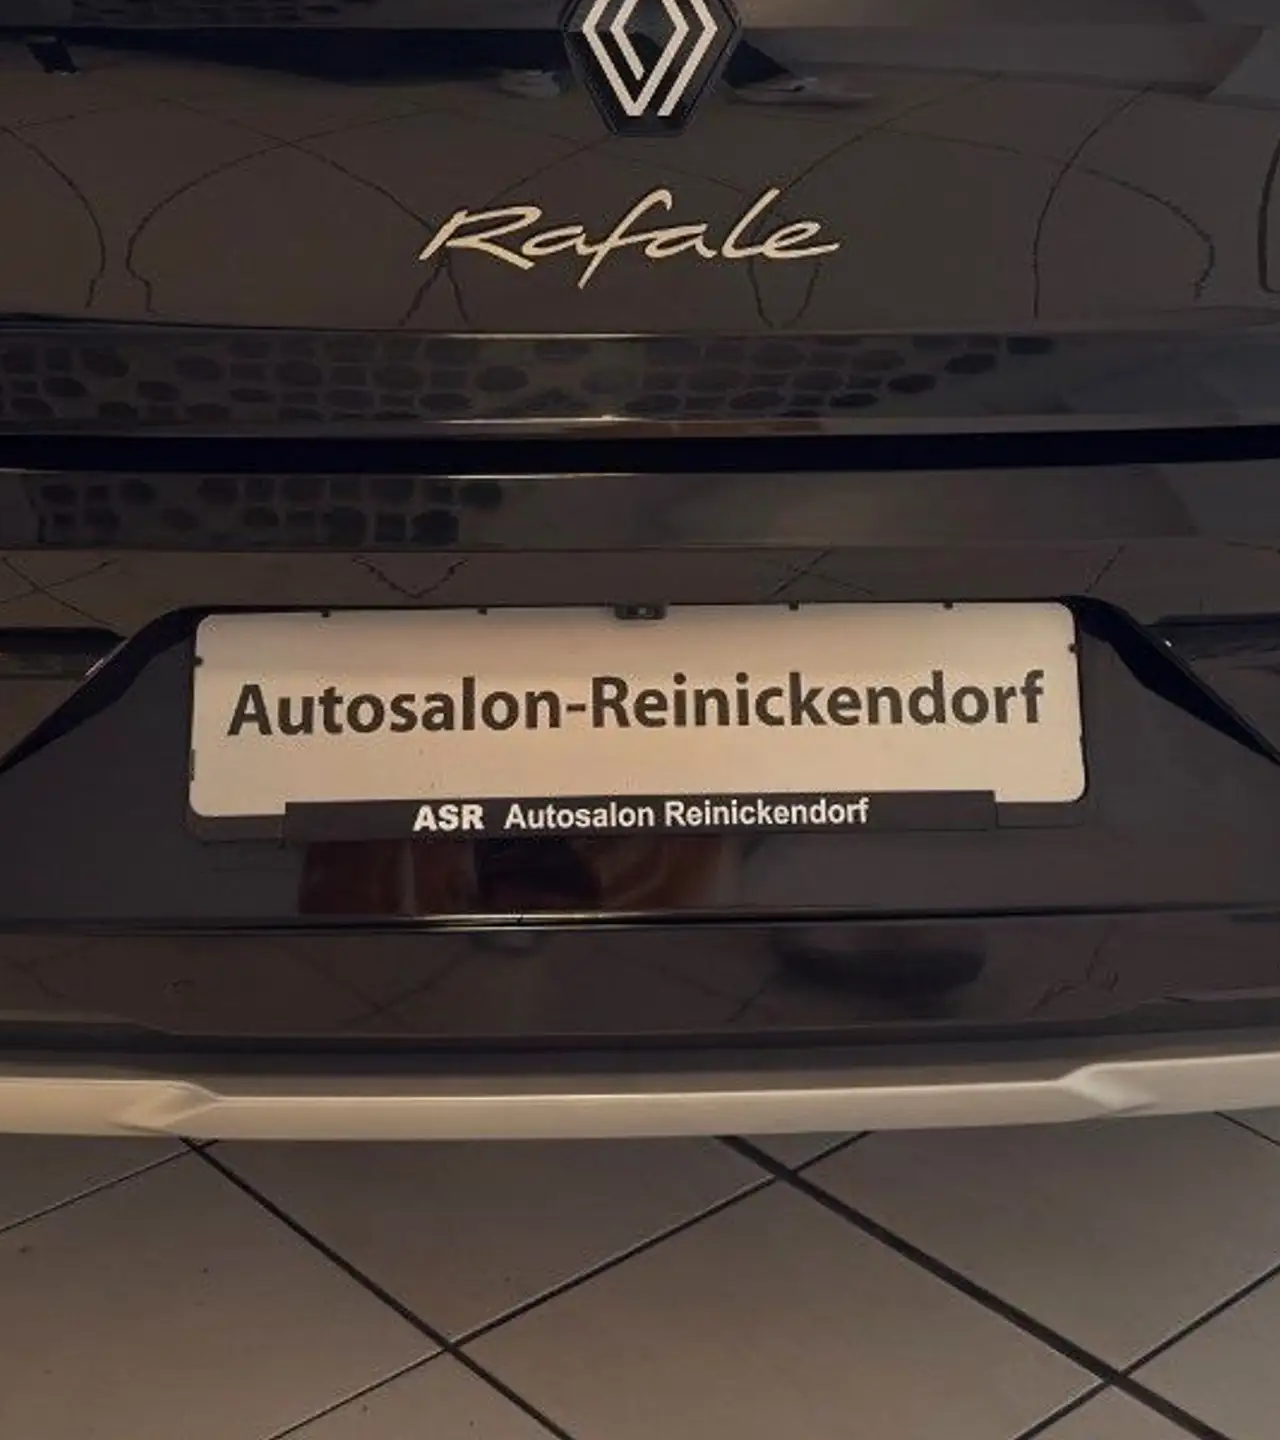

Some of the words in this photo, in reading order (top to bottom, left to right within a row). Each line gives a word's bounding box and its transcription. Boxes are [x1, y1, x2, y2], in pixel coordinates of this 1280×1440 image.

[418, 188, 841, 289] Rafale
[226, 669, 1045, 736] Autosalon-Reinickendorf
[412, 804, 485, 832] ASR
[503, 799, 656, 831] Autosalon
[665, 797, 870, 828] Reinickendorf
